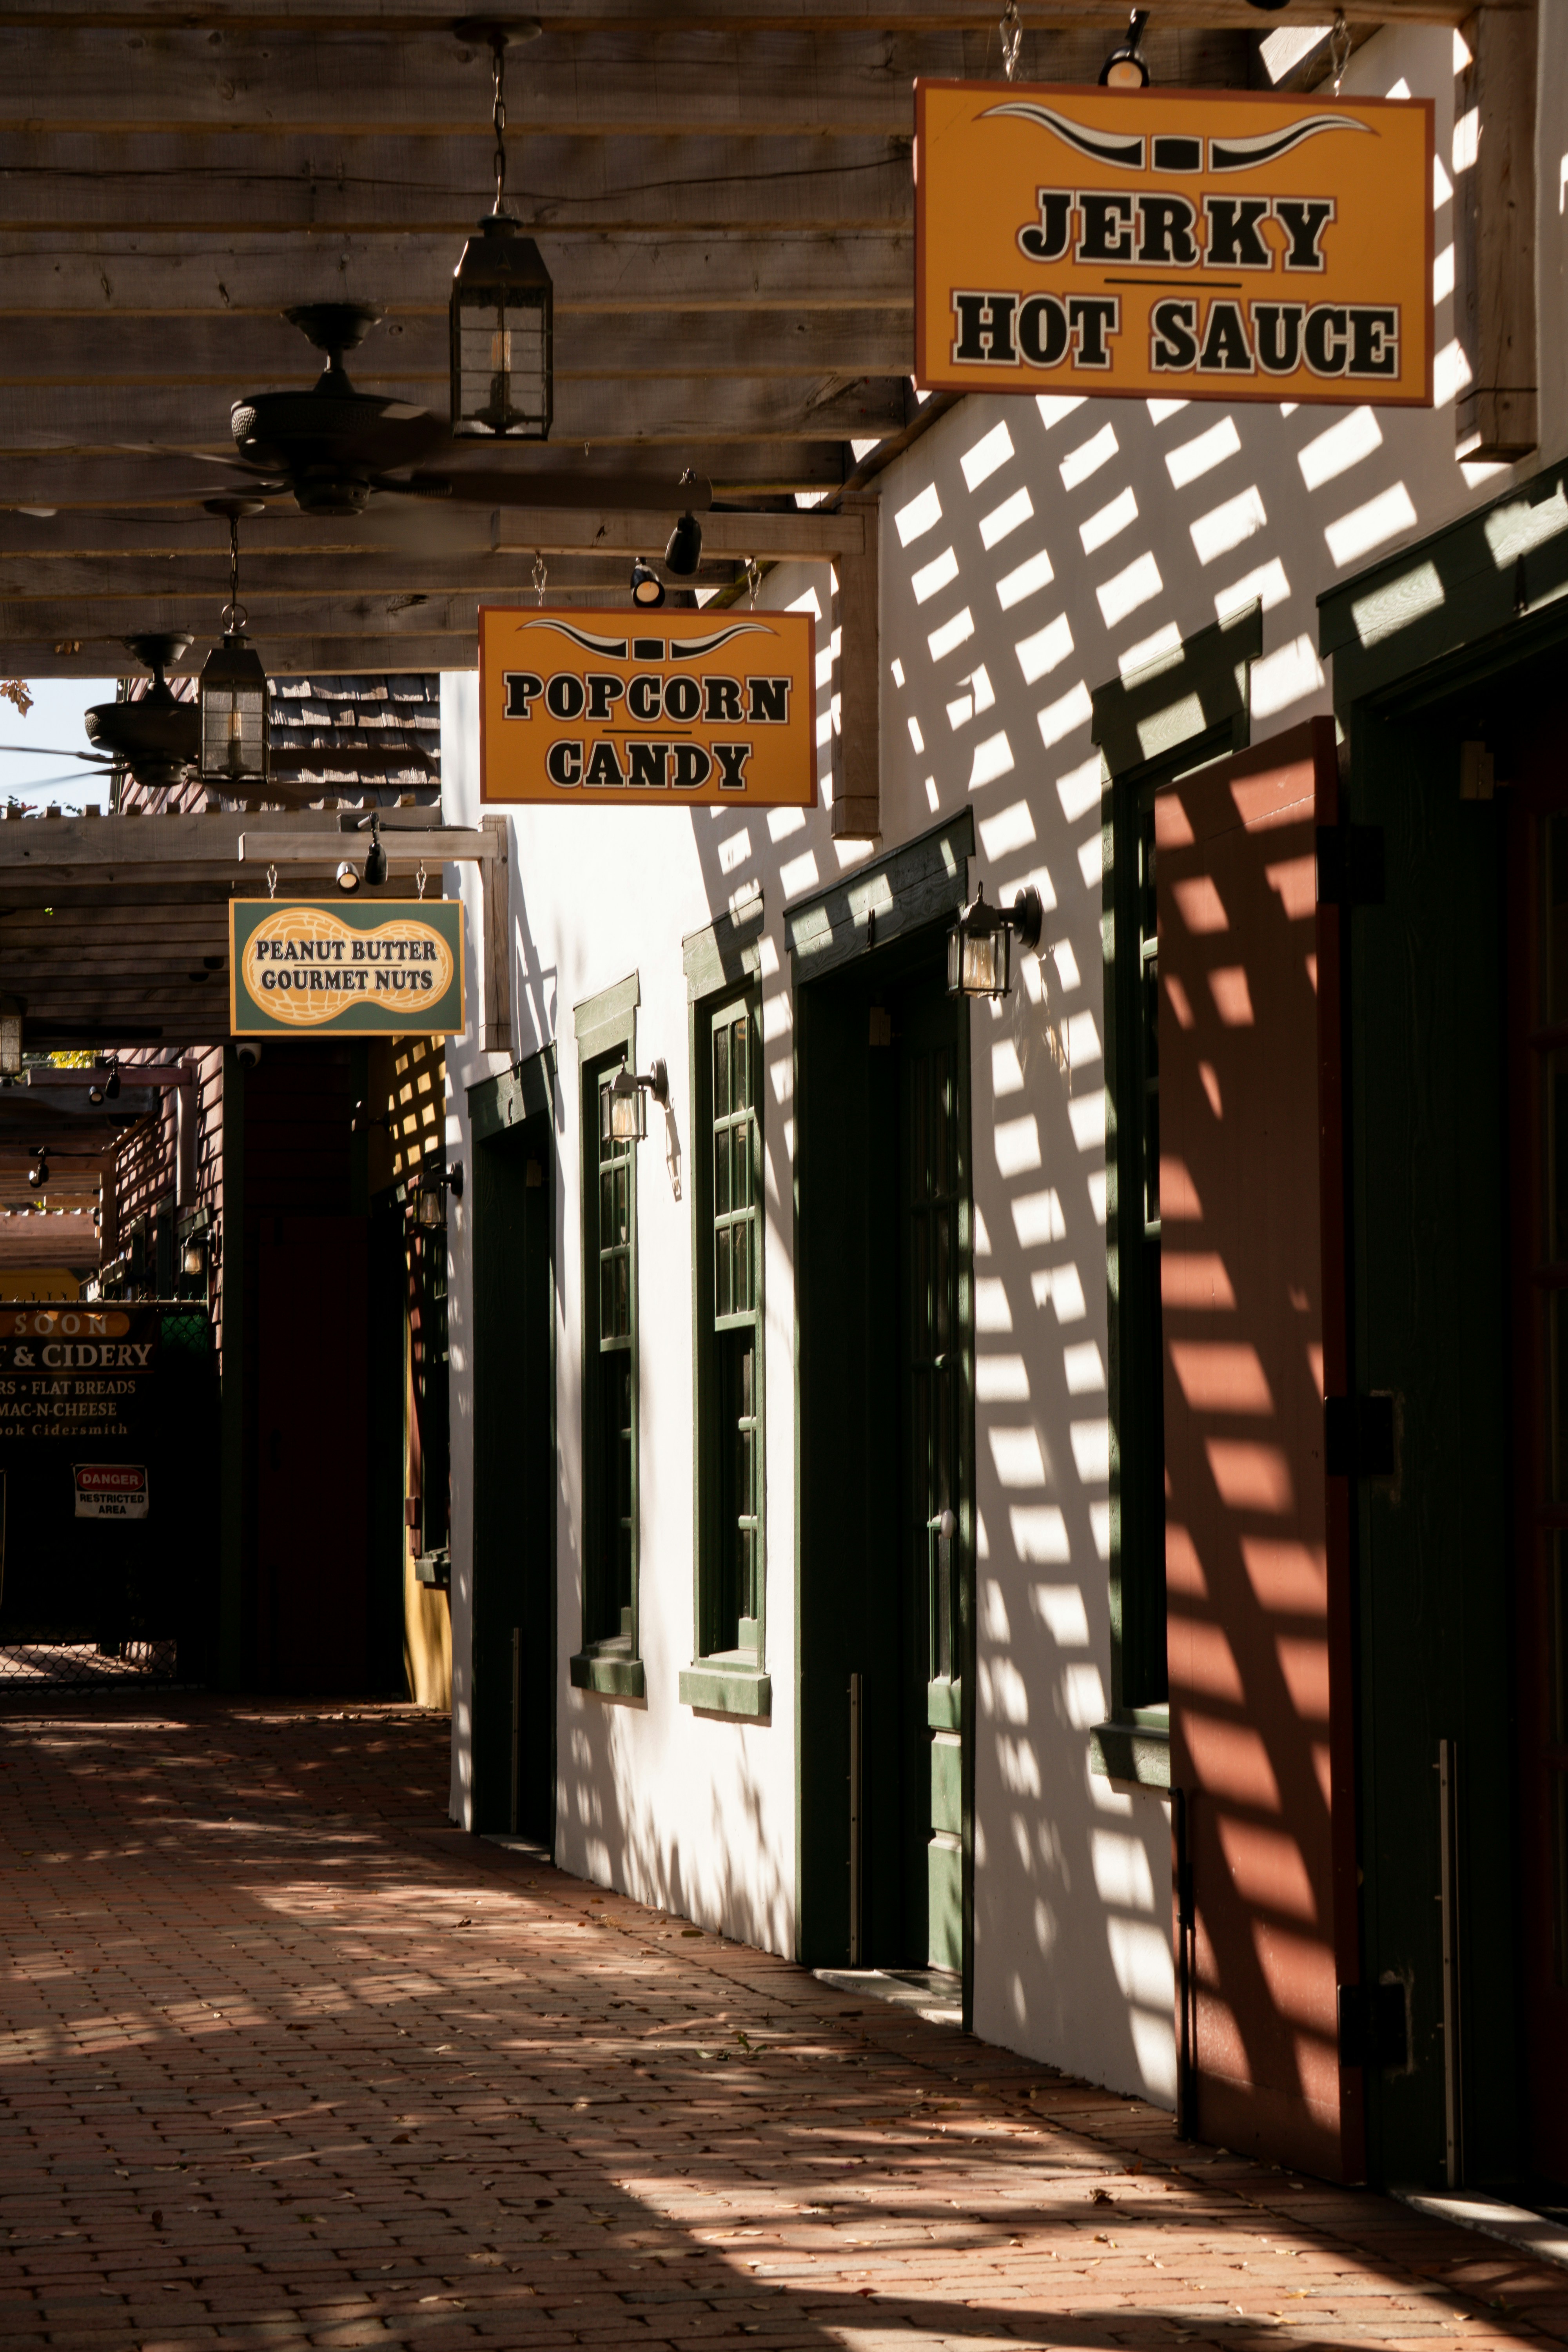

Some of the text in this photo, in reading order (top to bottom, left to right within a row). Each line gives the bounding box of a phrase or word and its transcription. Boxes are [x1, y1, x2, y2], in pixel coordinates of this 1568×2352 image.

[1018, 189, 1334, 271] JERKY
[953, 291, 1398, 379] HOT SAUCE
[504, 672, 791, 724] POPCORN
[546, 740, 751, 789] CANDY
[256, 940, 437, 960] PEANUT BUTTER
[261, 970, 433, 990] GOURMET NUTS
[15, 1314, 108, 1334] SOON
[13, 1346, 36, 1367] &
[42, 1343, 153, 1367] CIDERY
[31, 1381, 72, 1395] FLAT
[74, 1380, 136, 1395] BREADS
[0, 1402, 118, 1417] MAC-N-CHEESE
[32, 1423, 128, 1436] Cidersmith
[82, 1473, 139, 1485] DANGER
[80, 1494, 144, 1503] RESTRICTED
[99, 1505, 126, 1514] AREA
